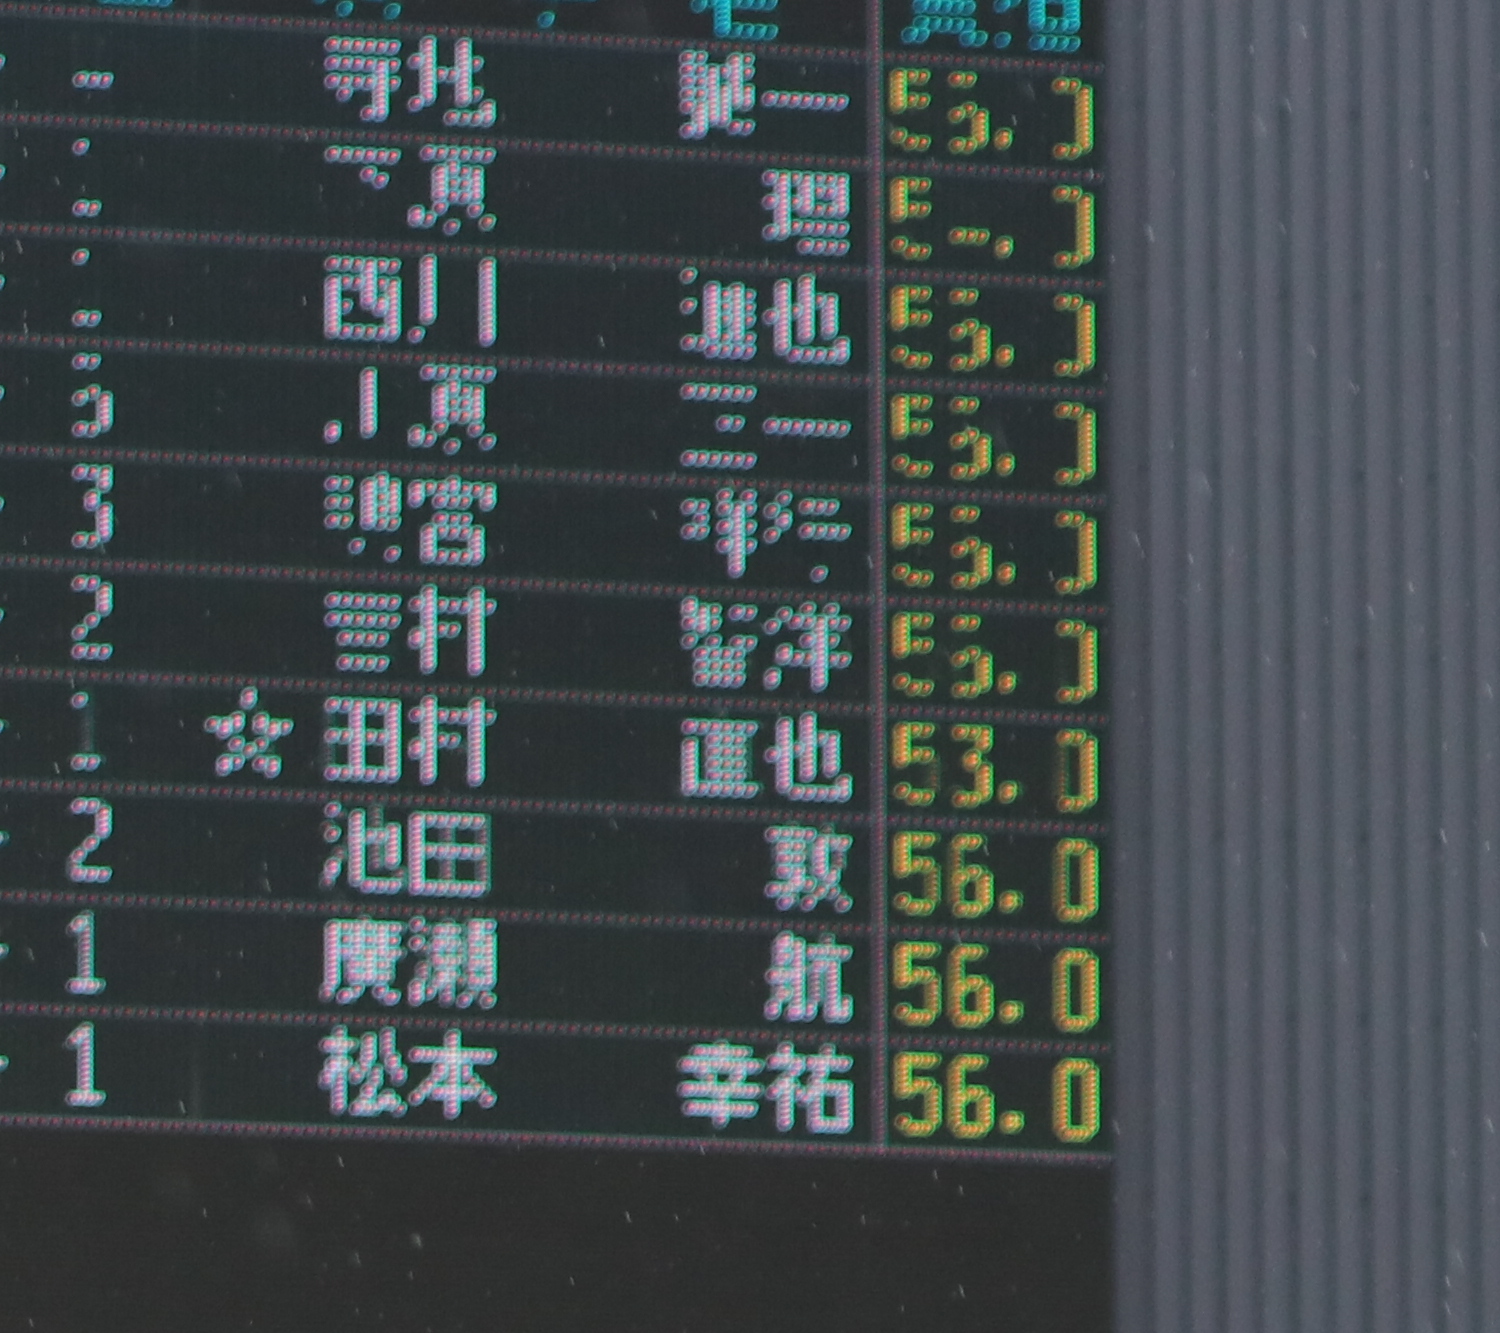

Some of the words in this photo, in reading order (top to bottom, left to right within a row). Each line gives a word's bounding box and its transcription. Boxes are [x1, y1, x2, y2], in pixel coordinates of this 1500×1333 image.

[71, 463, 114, 549] 3
[70, 575, 114, 661] 2
[323, 696, 498, 787] 田村
[70, 797, 113, 883] 2
[323, 807, 498, 898] 池田
[893, 831, 1100, 921] 56.0
[69, 911, 107, 995] 1
[322, 920, 498, 1010] 廣瀬
[764, 937, 854, 1024] 航
[893, 942, 1100, 1032] 56.0
[68, 1023, 107, 1107] 1
[318, 1032, 498, 1119] 松本
[680, 1045, 854, 1134] 幸祐
[894, 1052, 1101, 1143] 56.0
